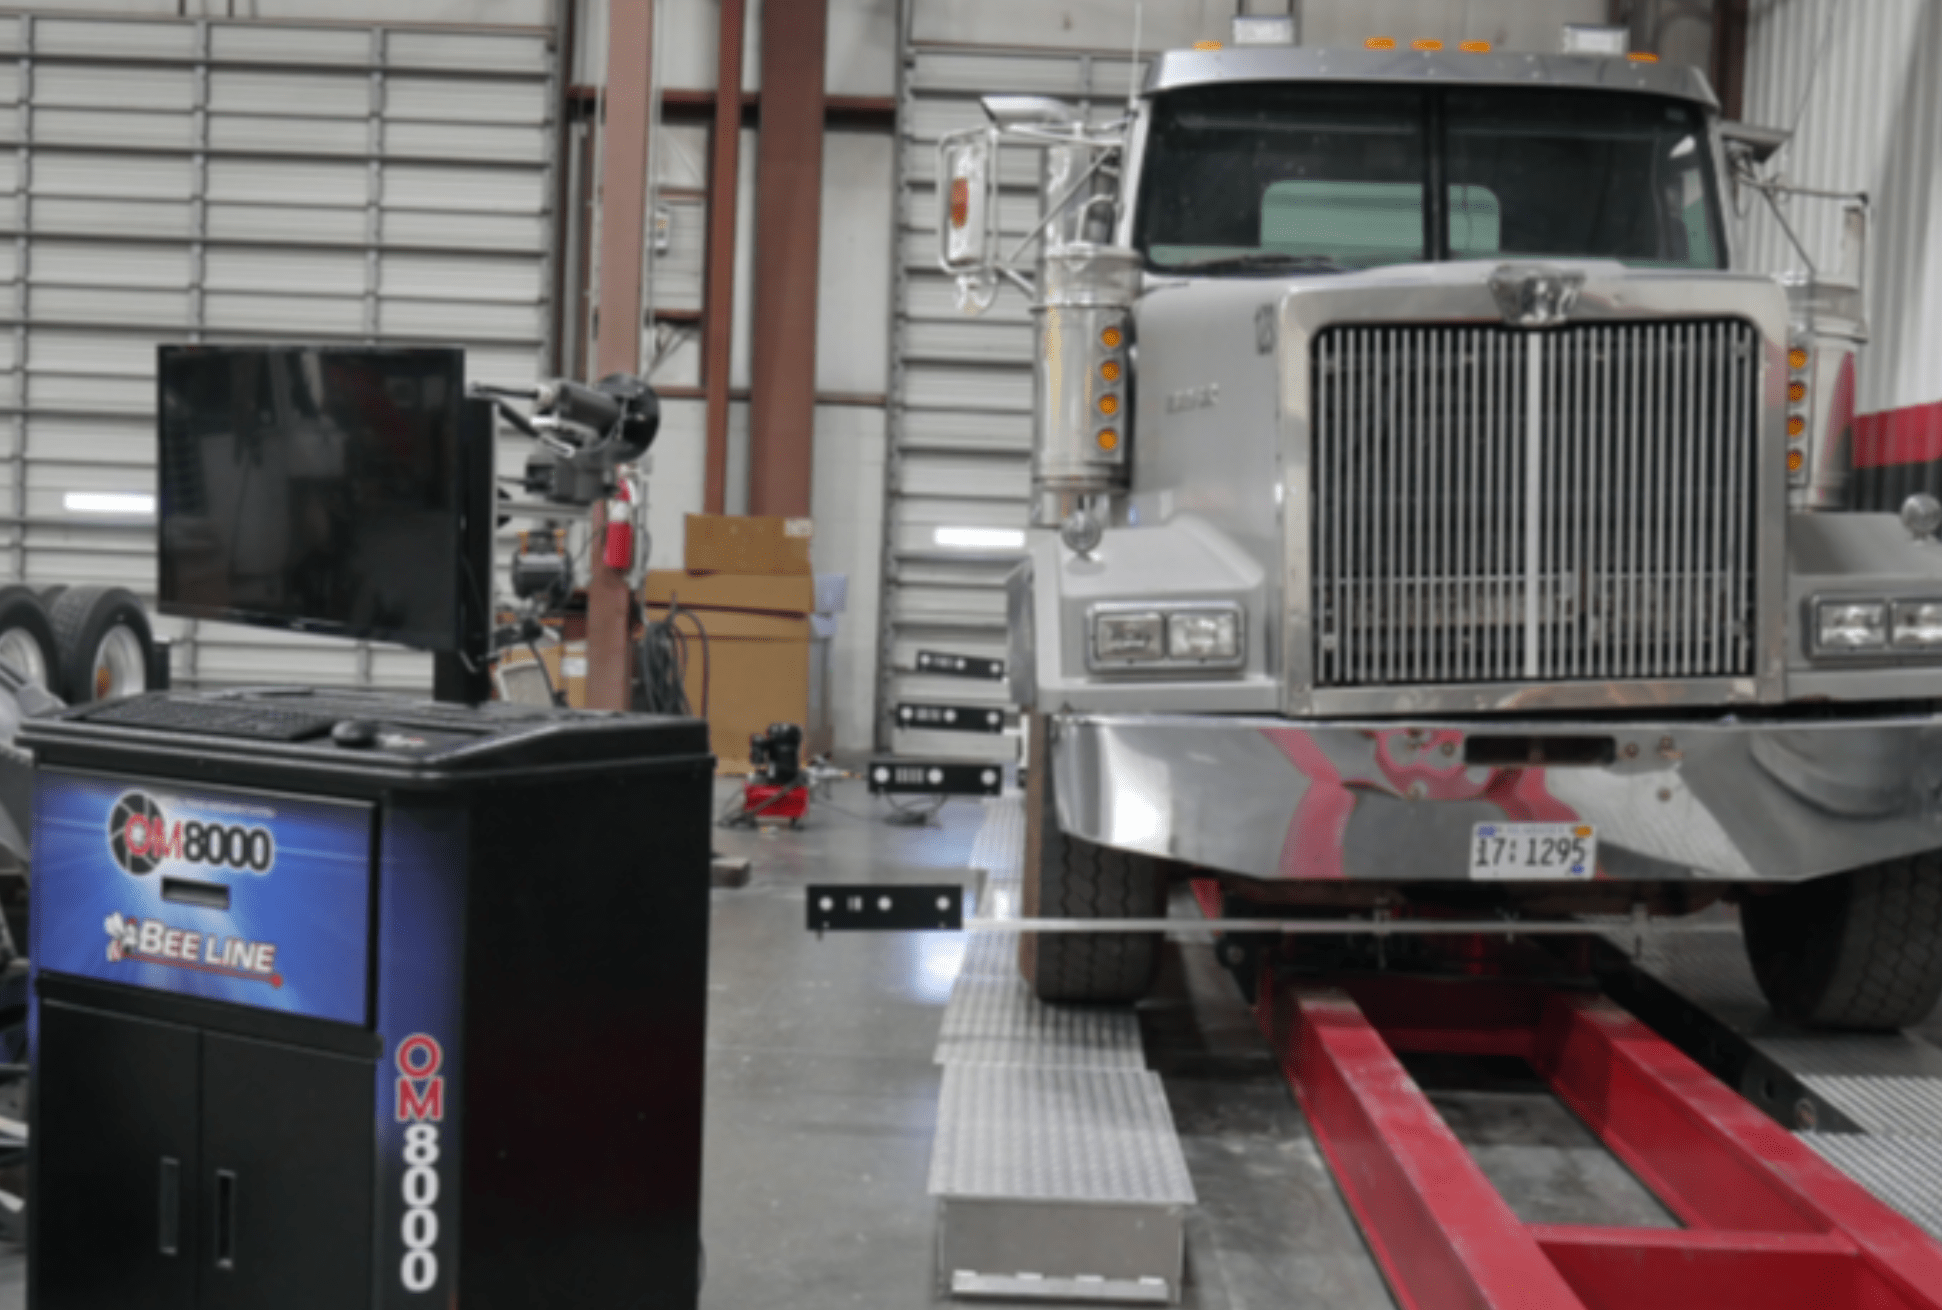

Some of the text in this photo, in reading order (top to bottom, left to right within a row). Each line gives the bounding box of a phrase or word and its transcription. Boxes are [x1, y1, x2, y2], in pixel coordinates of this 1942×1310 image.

[123, 812, 272, 874] OM8000
[138, 918, 276, 974] BEE LINE
